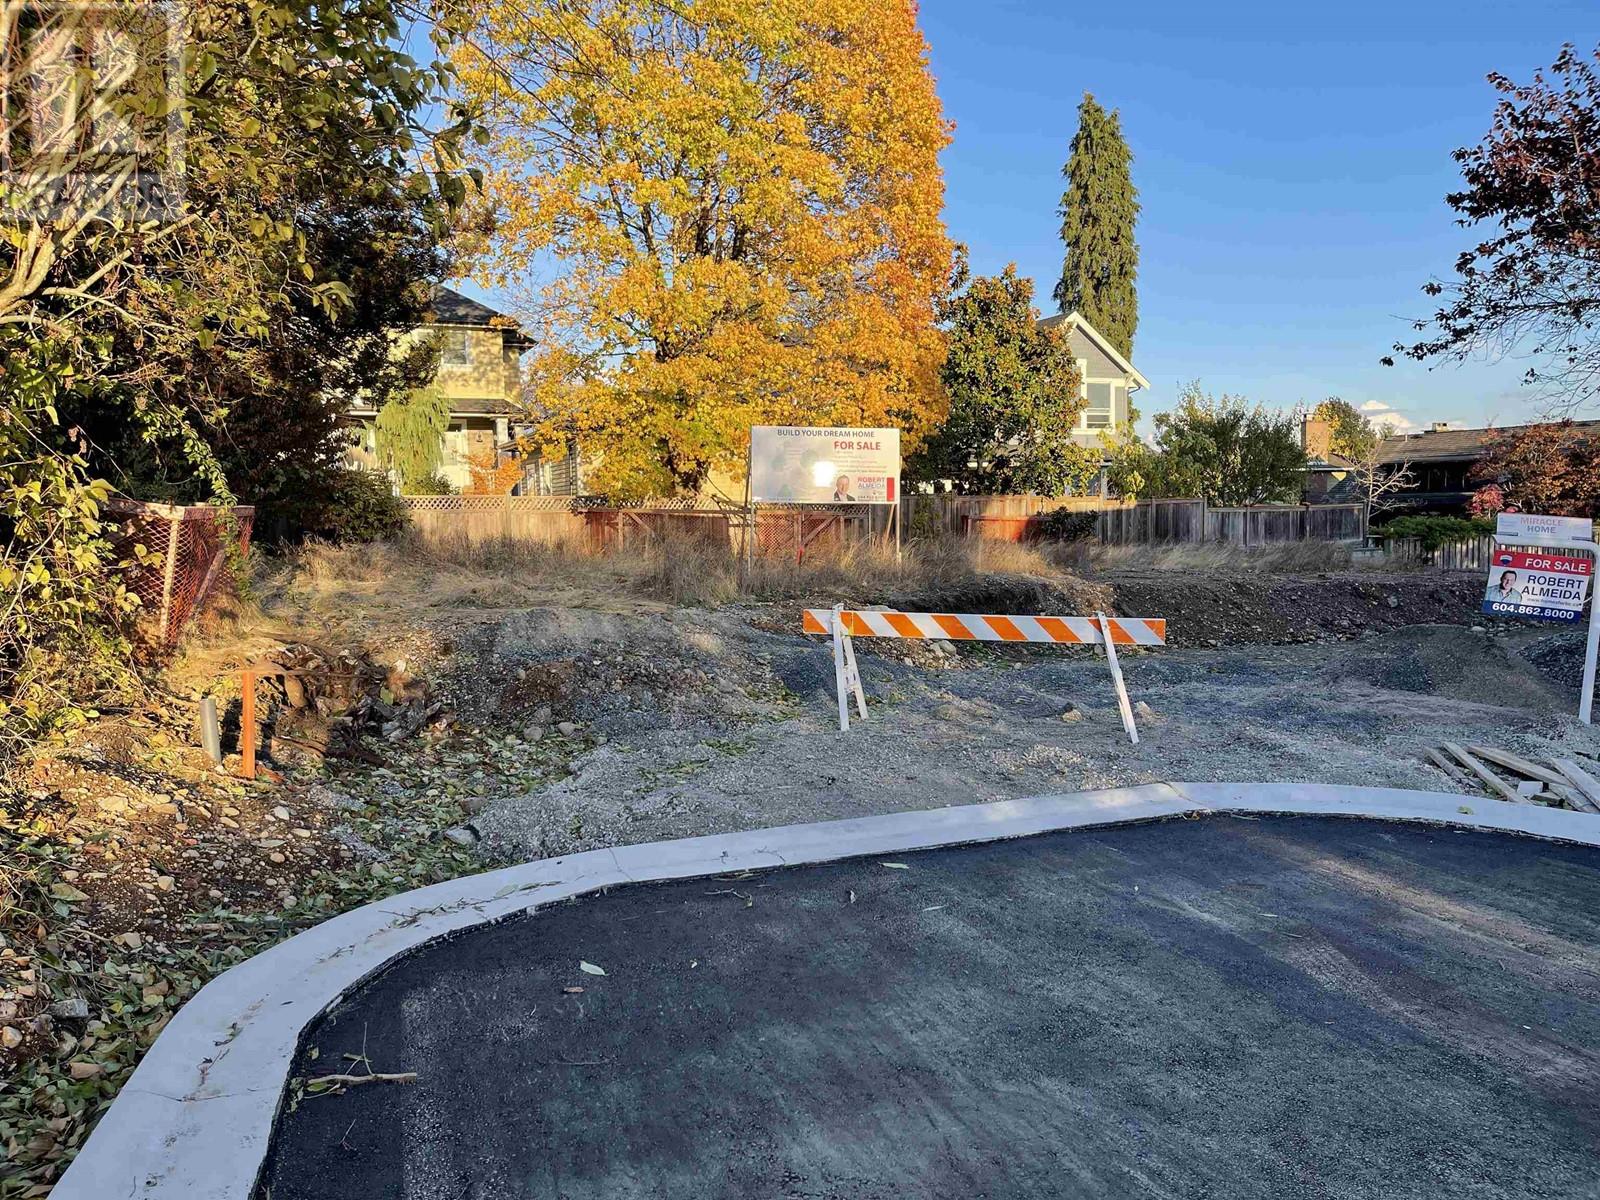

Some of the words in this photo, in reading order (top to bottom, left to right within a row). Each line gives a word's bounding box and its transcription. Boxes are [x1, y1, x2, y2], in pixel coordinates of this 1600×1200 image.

[834, 441, 854, 450] FOR
[857, 442, 881, 450] SALE
[1521, 518, 1565, 526] MIRACLE
[1527, 526, 1557, 534] HOME
[1525, 558, 1551, 569] FOR
[1554, 561, 1587, 573] SALE
[1527, 575, 1584, 589] ROBERT
[1521, 586, 1581, 600] ALMEIDA
[1492, 602, 1575, 619] 604.862.8000
